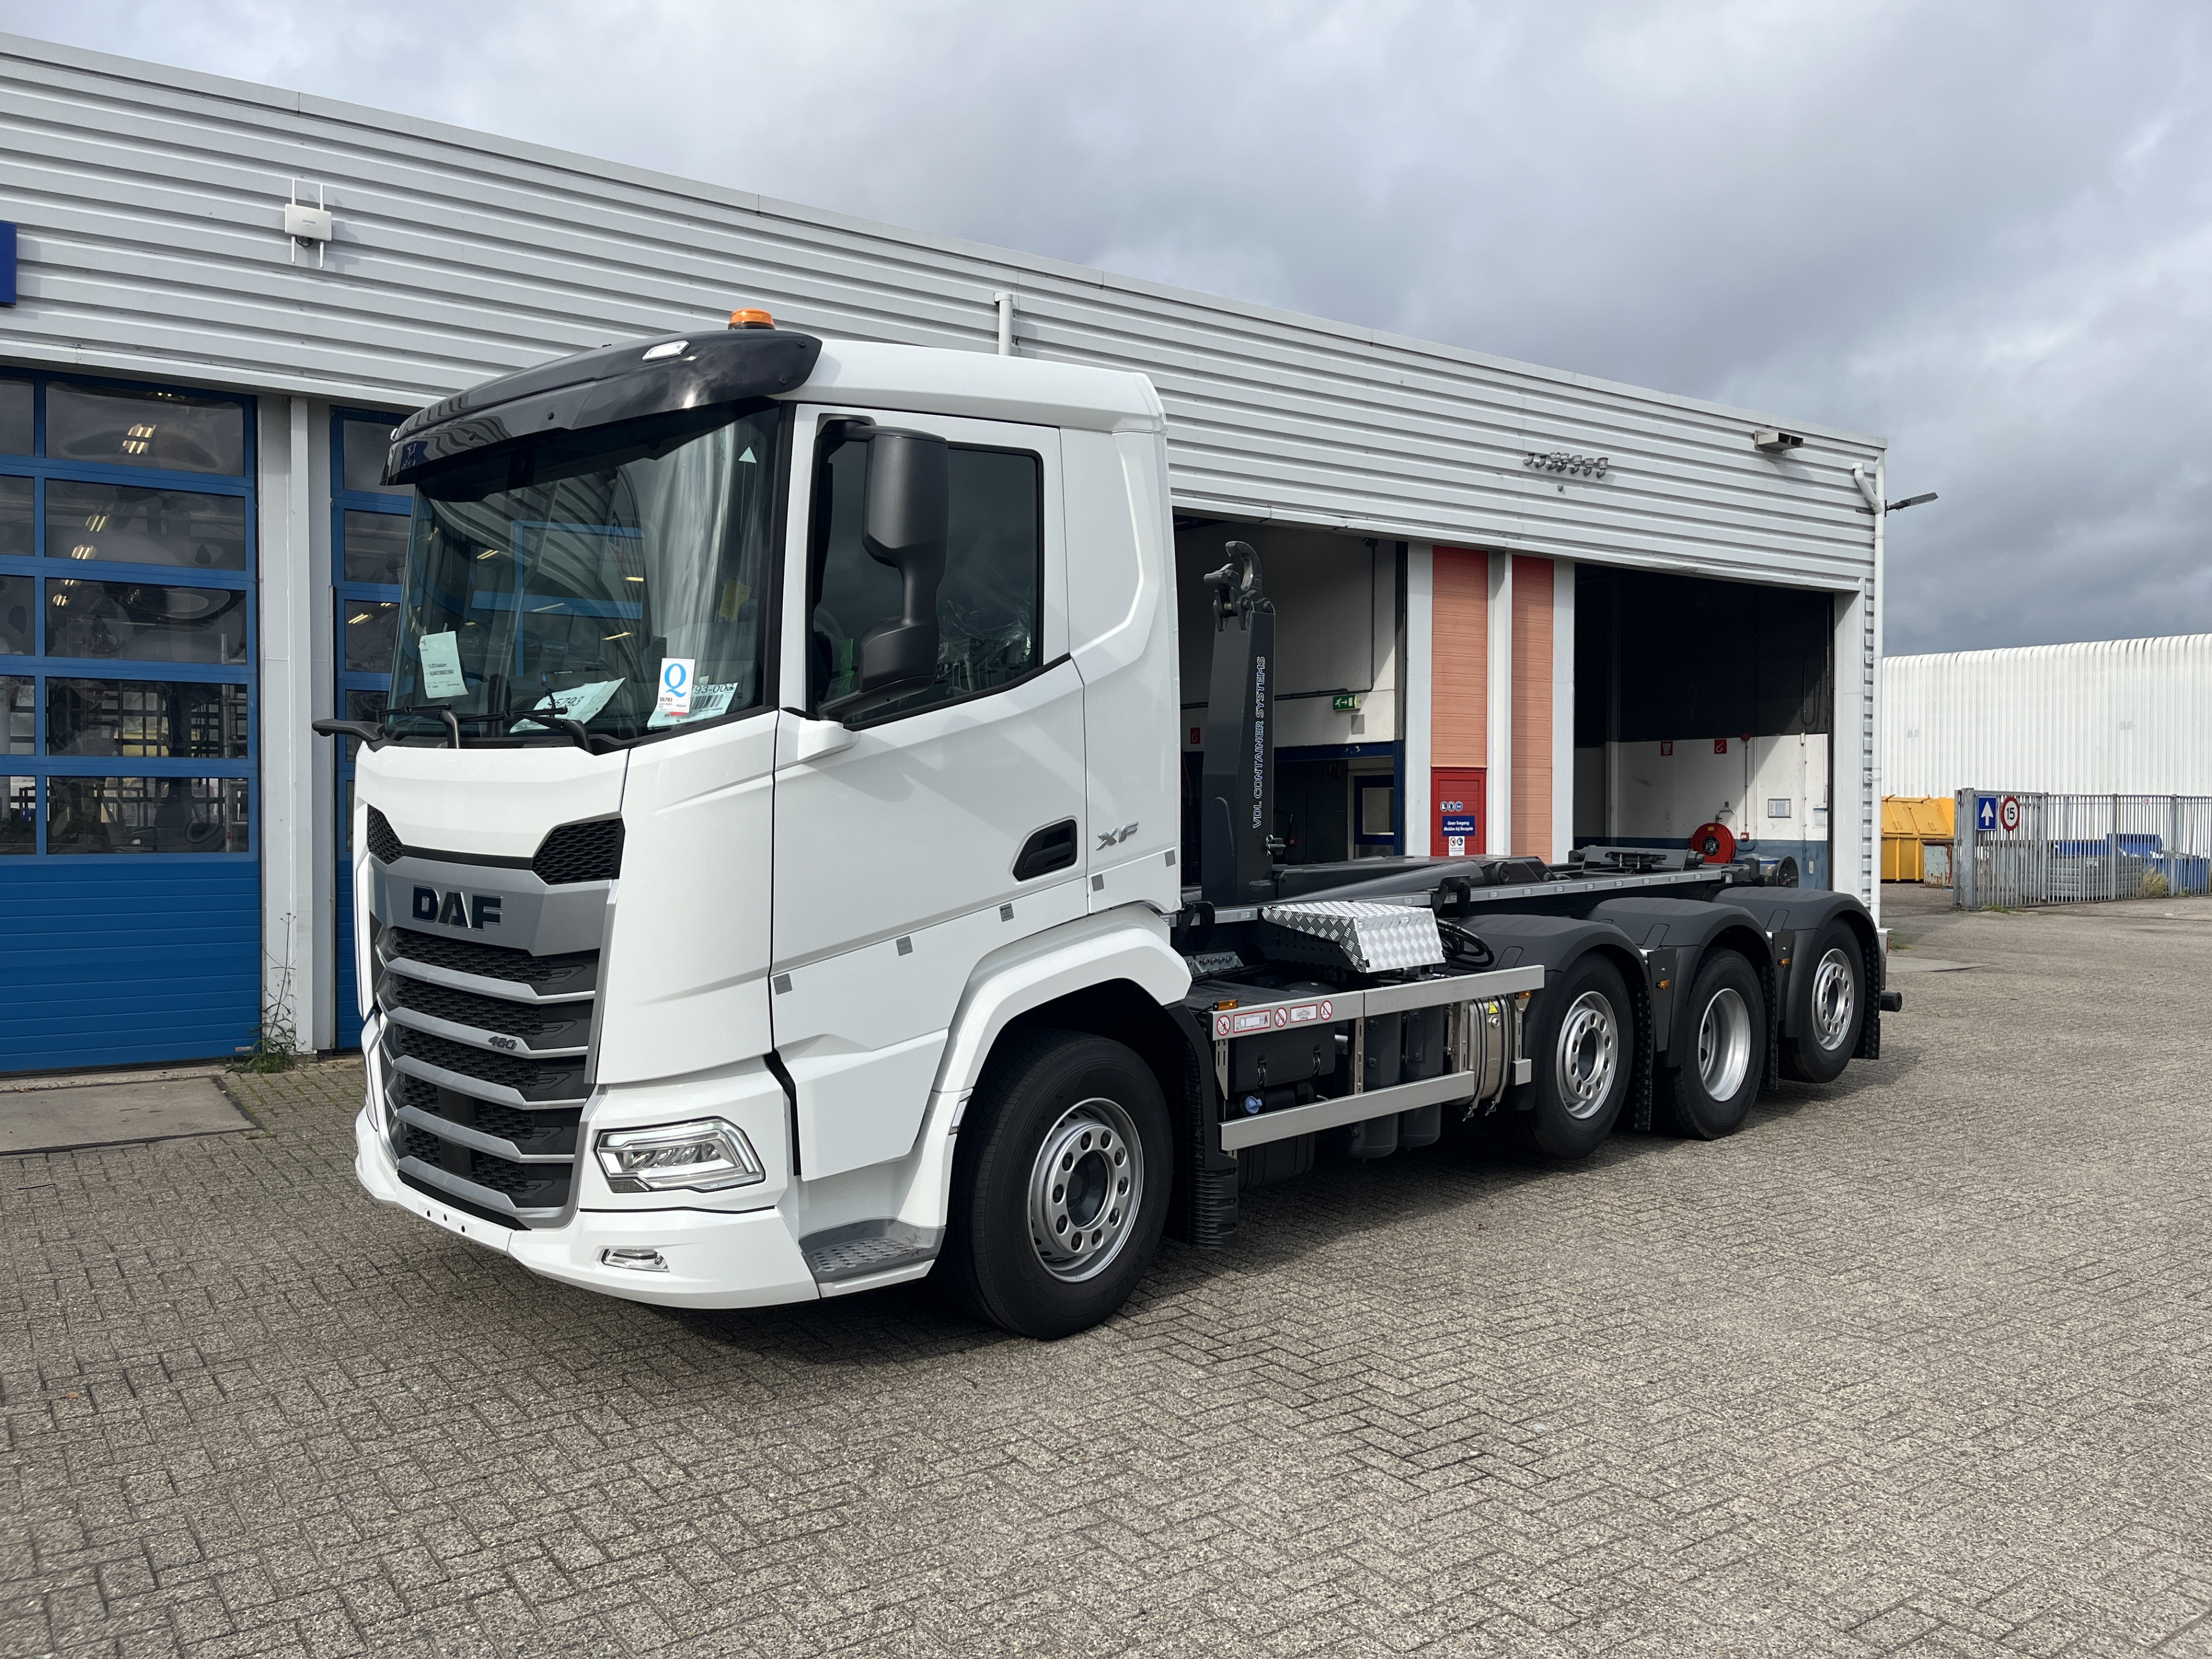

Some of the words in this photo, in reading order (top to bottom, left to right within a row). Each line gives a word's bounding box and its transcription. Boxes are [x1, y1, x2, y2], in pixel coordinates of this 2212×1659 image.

[664, 663, 686, 698] Q
[1256, 656, 1266, 718] SYSTEMS
[1254, 721, 1264, 798] CONTAINER
[1253, 801, 1262, 828] VDL
[2007, 807, 2015, 820] 15
[1096, 821, 1138, 851] XF
[412, 885, 503, 931] DAF
[488, 1036, 517, 1050] 480
